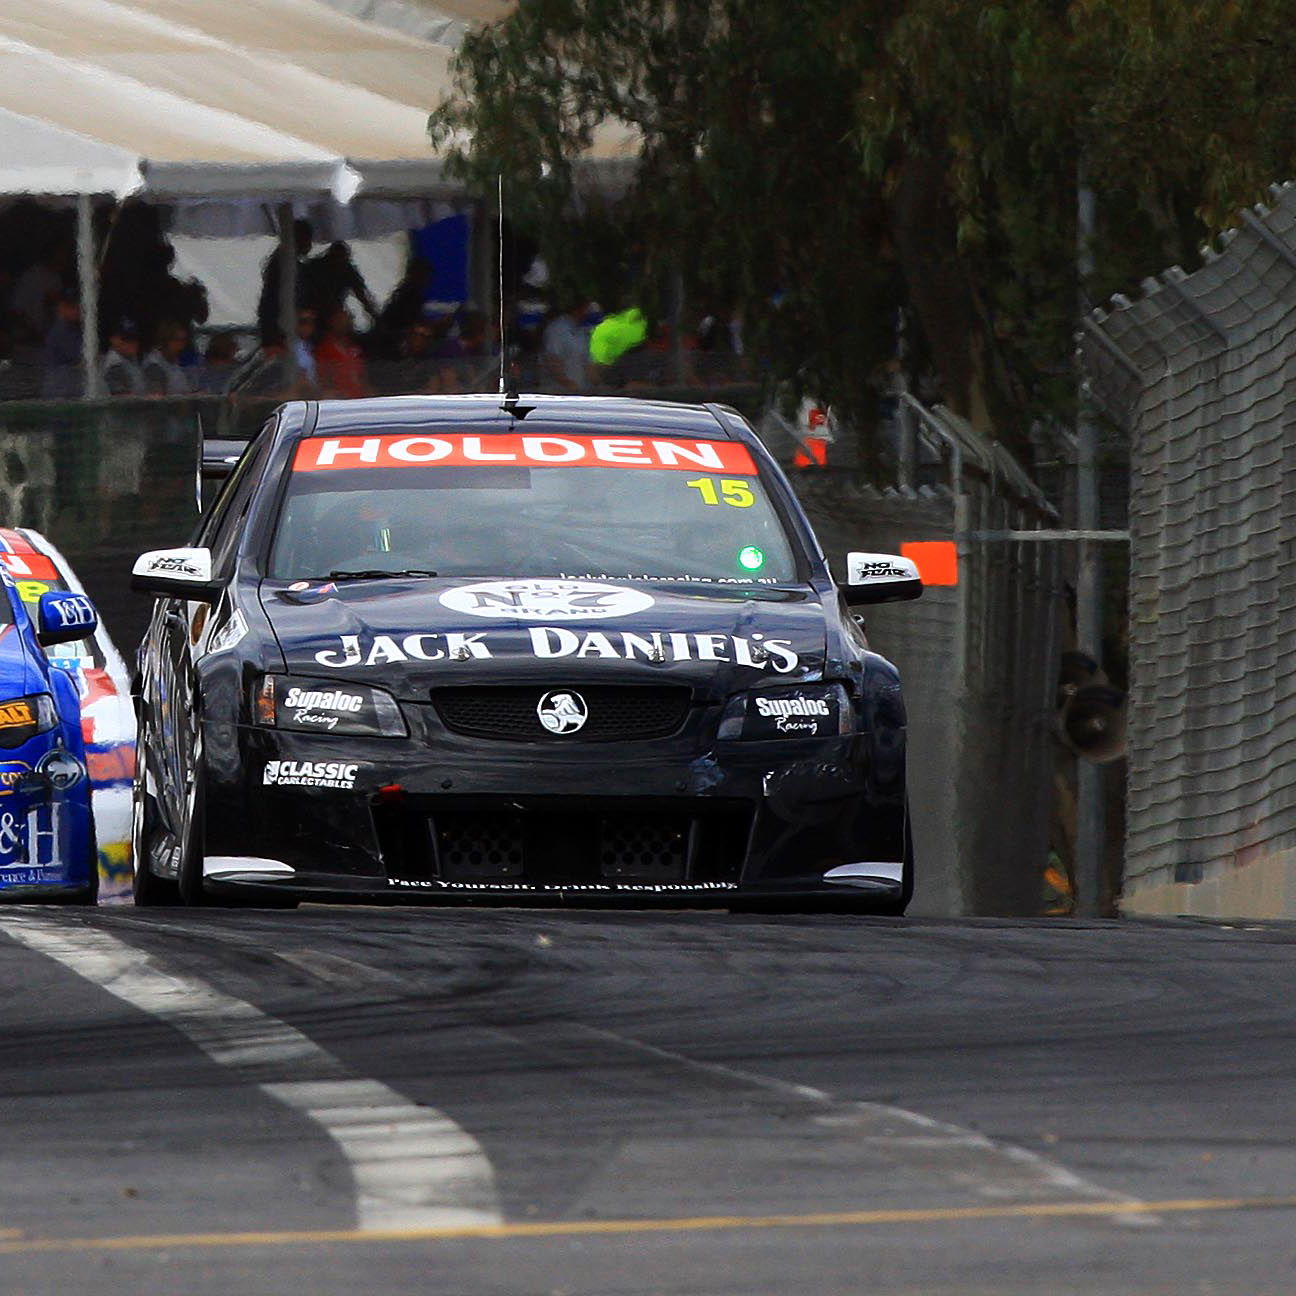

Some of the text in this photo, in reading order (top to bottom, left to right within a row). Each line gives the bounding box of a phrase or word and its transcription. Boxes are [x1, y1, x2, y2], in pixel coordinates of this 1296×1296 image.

[315, 437, 725, 469] HOLDEN
[686, 477, 756, 509] 15
[314, 625, 800, 674] JACK DANIEL'S
[284, 687, 364, 713] Supaloc
[755, 697, 830, 717] Supaloc
[292, 707, 339, 730] Racing
[776, 717, 818, 735] Racing
[279, 760, 359, 781] CLASSIC
